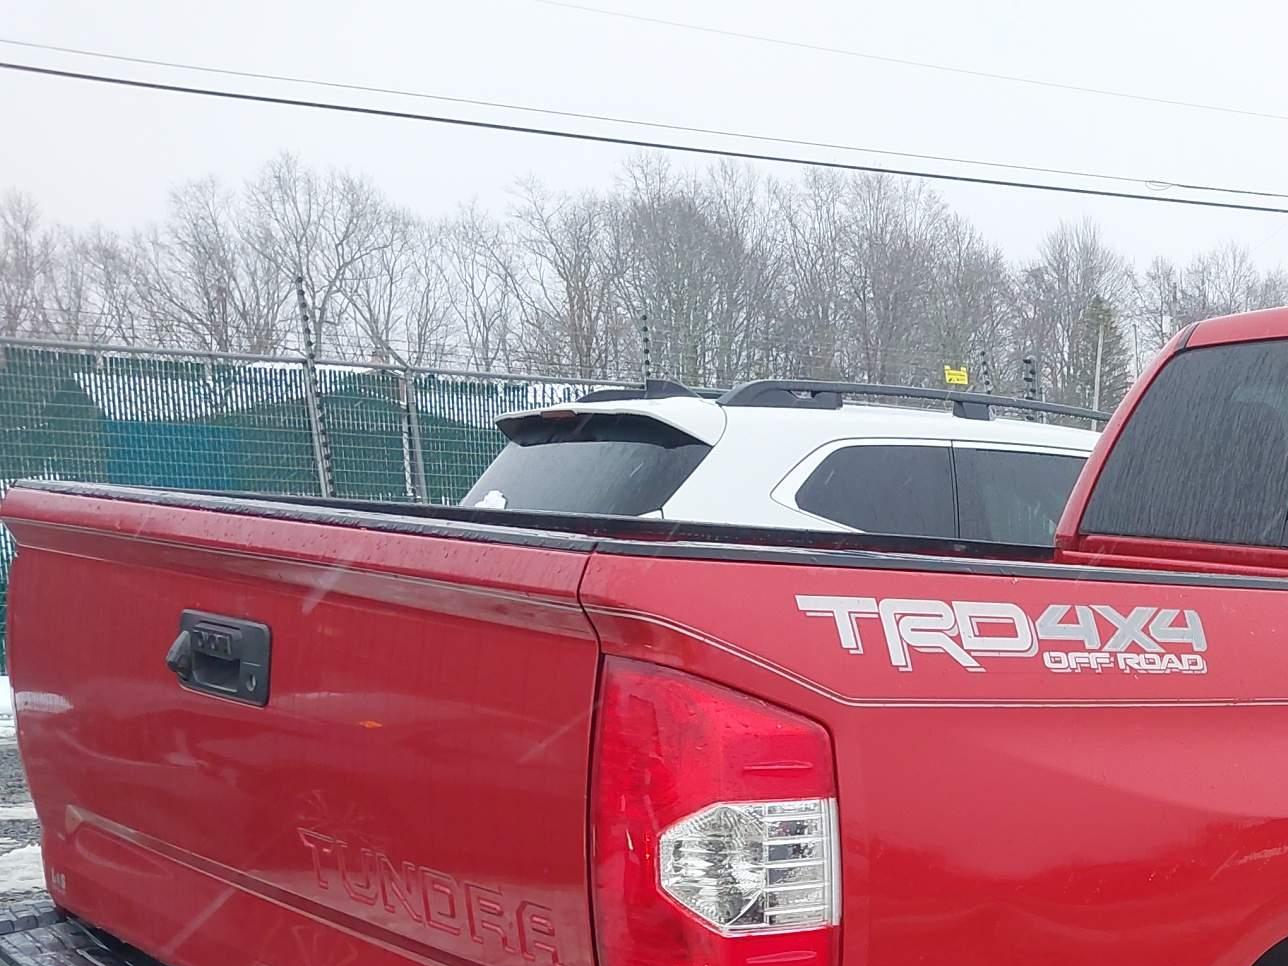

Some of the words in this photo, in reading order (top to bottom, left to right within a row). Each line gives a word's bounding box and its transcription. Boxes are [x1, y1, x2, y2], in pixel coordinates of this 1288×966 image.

[795, 594, 1040, 672] TRD
[1043, 651, 1115, 673] OFF
[1117, 653, 1208, 674] ROAD
